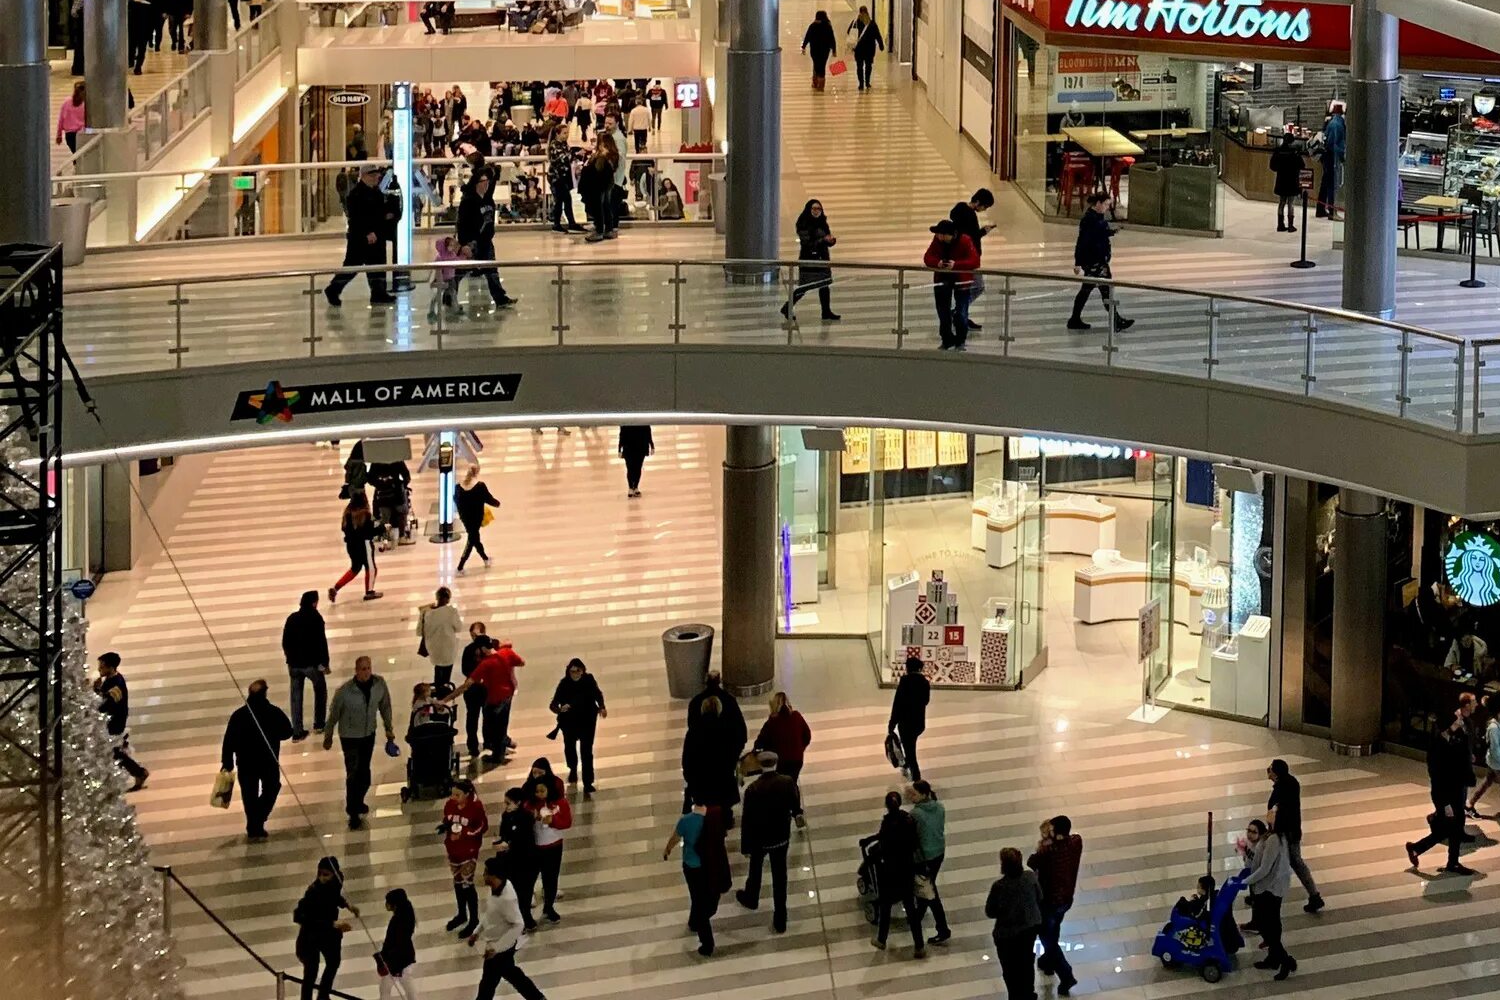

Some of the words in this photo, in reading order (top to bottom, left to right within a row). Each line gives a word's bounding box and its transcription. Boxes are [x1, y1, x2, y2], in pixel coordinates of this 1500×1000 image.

[1059, 57, 1113, 70] BLOOMINGTON
[1114, 56, 1136, 67] MN
[1063, 76, 1084, 89] 1974
[310, 390, 366, 407] MALL
[374, 386, 403, 400] OF
[411, 381, 506, 399] AMERICA
[927, 631, 939, 640] 22
[948, 631, 960, 641] 15
